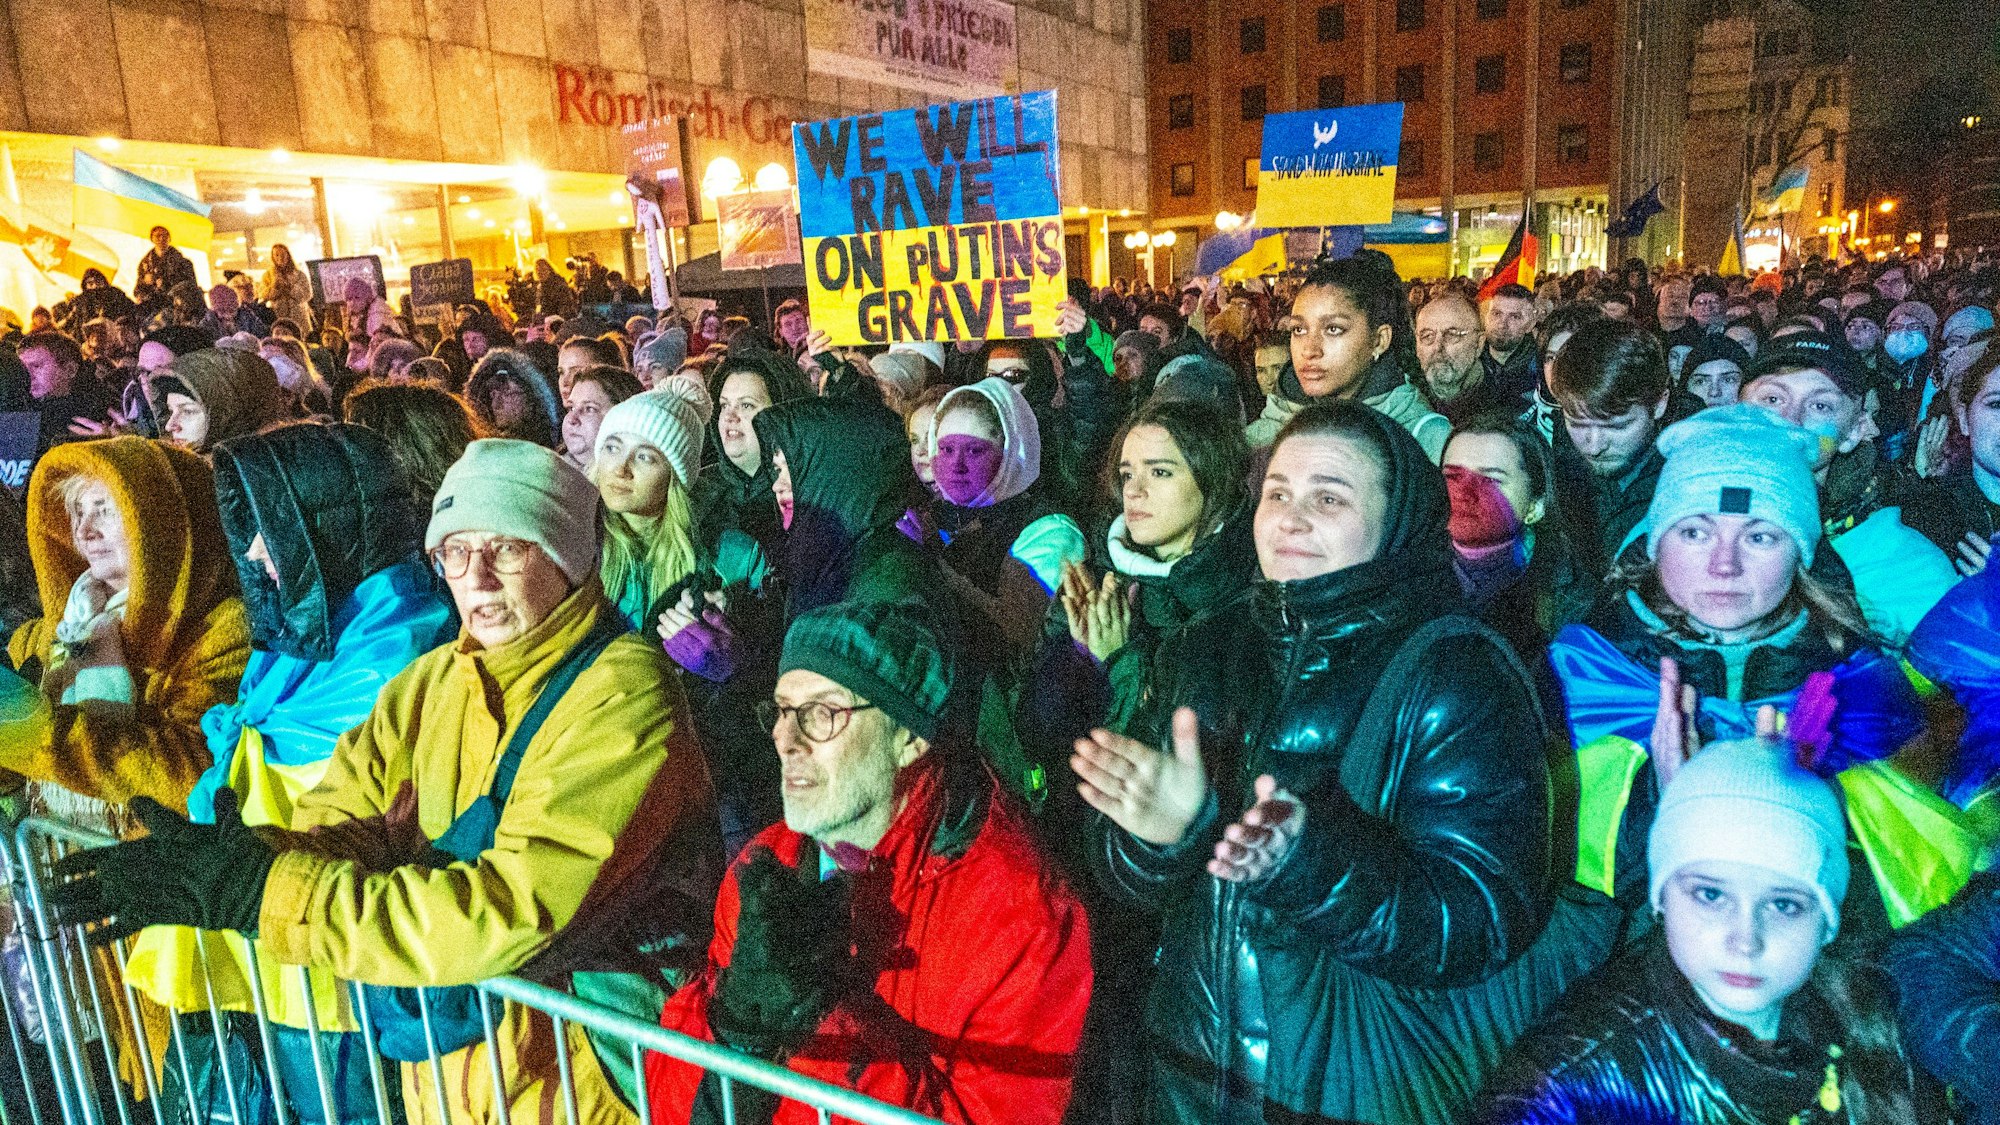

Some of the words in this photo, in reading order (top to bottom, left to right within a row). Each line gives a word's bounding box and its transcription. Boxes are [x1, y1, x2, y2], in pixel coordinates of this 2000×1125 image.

[800, 115, 887, 181] WE
[916, 95, 1048, 167] WILL
[851, 159, 997, 233] RAVE
[815, 232, 885, 292] ON
[906, 220, 1062, 286] PUTIN'S
[858, 278, 1035, 343] GRAVE
[1795, 341, 1830, 351] FARAH
